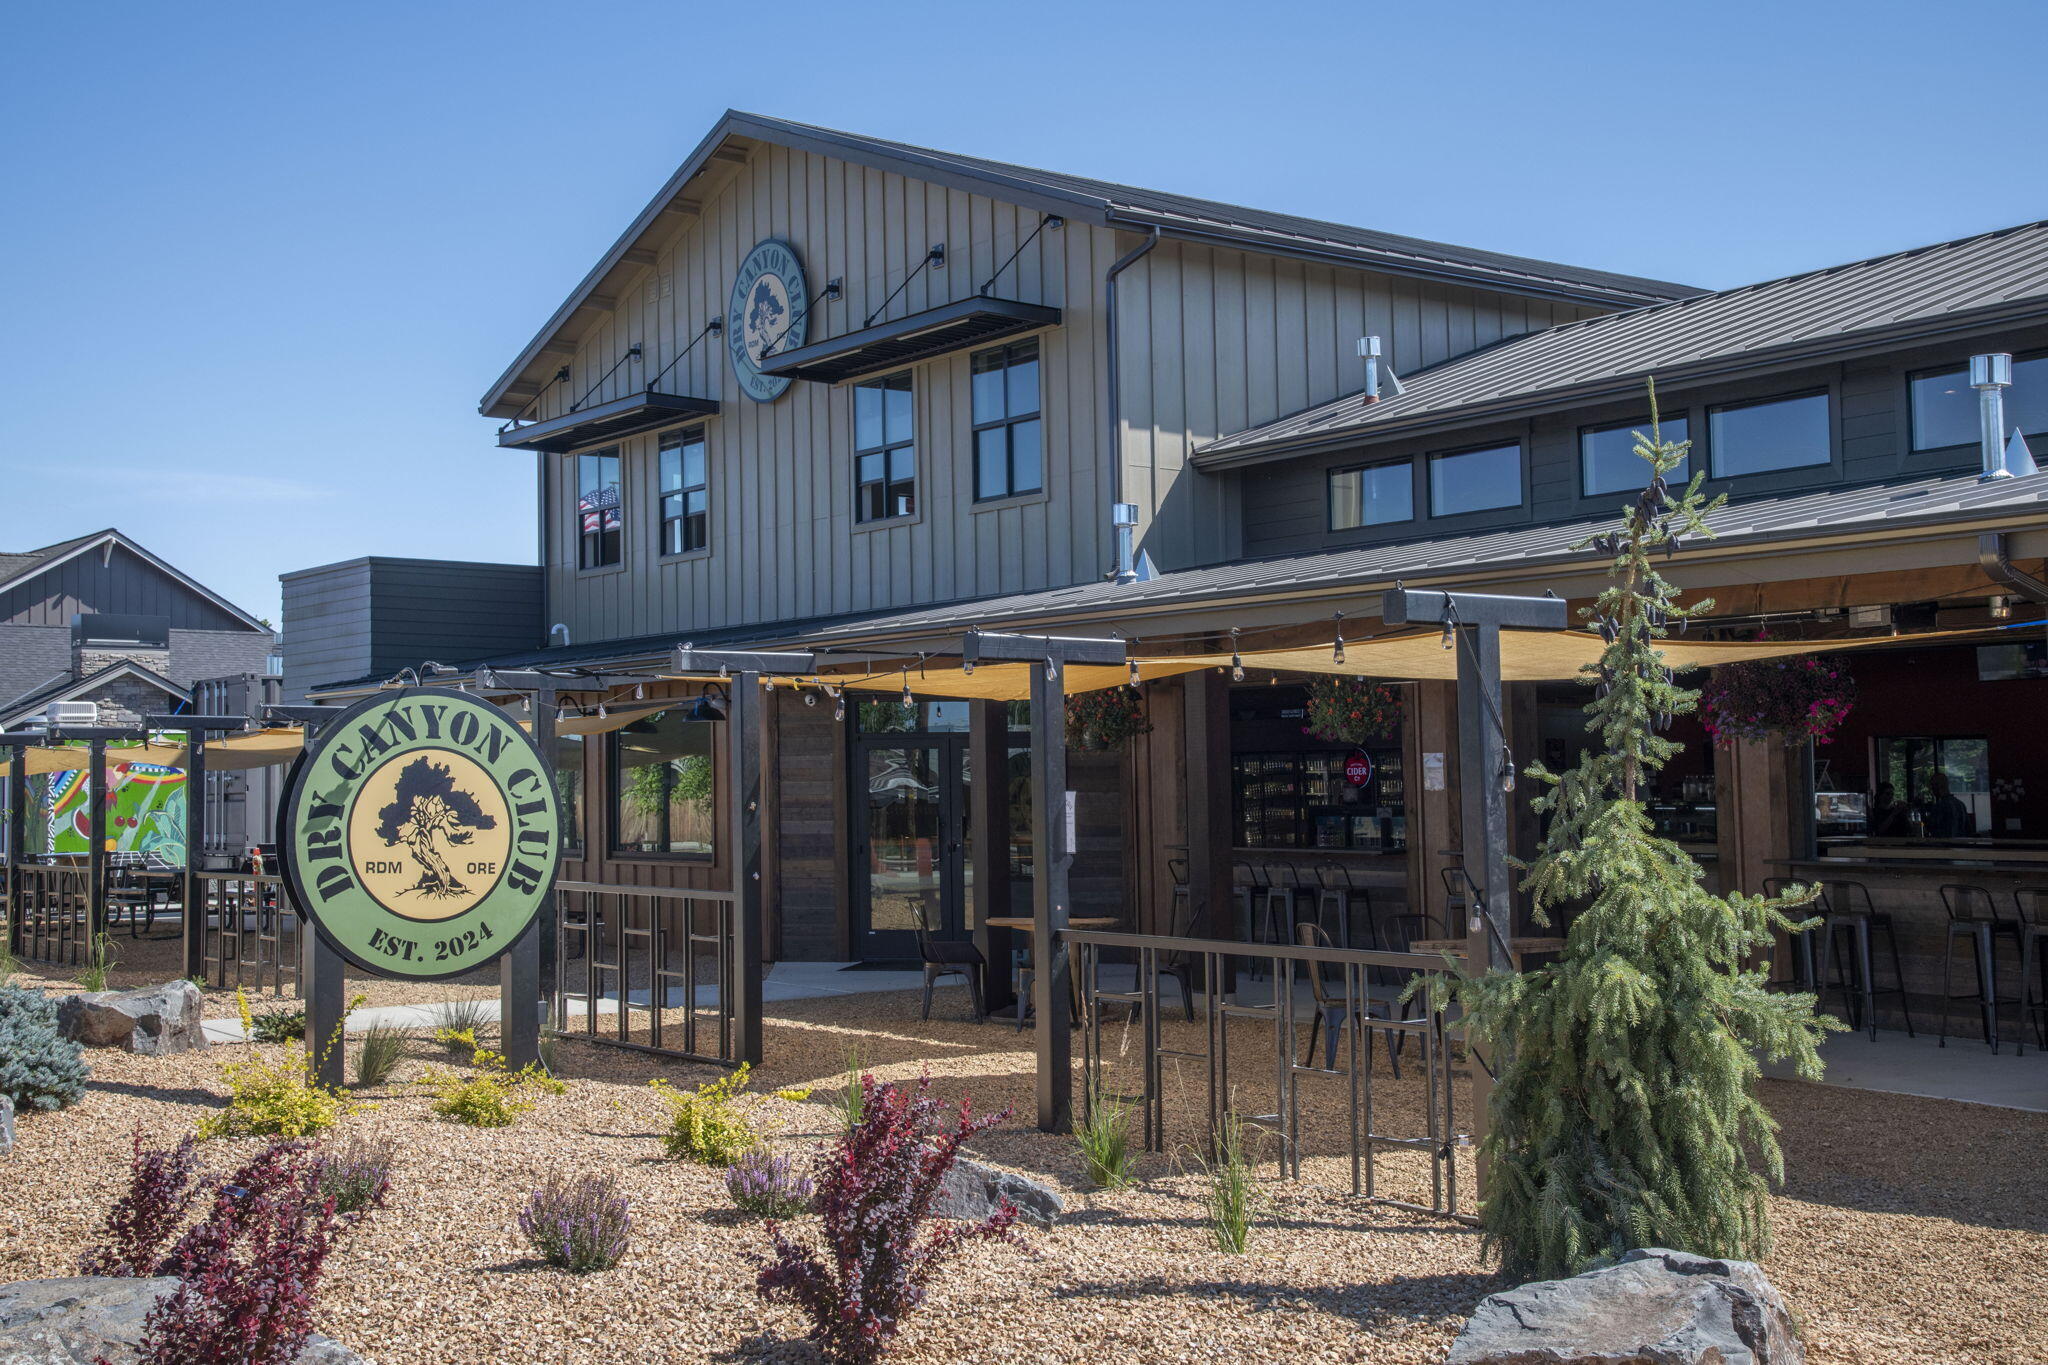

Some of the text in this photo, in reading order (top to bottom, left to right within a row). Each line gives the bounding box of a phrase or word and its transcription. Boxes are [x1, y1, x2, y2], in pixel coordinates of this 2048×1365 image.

[738, 249, 790, 300] CANYON
[732, 310, 746, 364] DRY
[1346, 767, 1367, 776] CIDER
[307, 704, 550, 903] DRY CANYON CLUB
[365, 861, 496, 875] RDM ORE
[367, 920, 494, 962] EST. 2024
